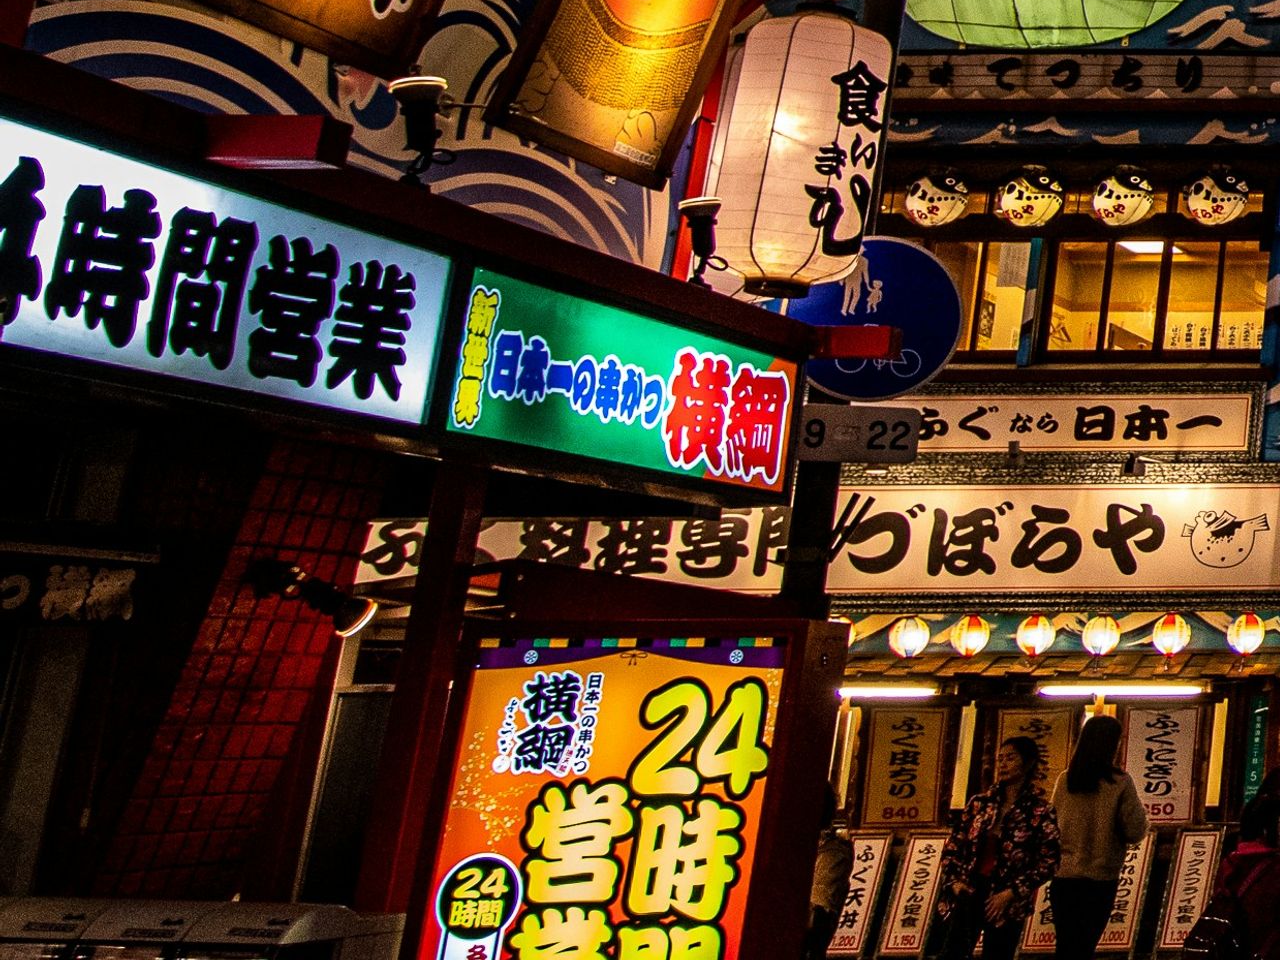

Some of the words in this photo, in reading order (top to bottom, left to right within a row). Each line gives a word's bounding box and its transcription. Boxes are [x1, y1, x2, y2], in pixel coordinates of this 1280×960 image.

[458, 286, 499, 426] 新世界
[488, 334, 665, 430] 日本一の串かつ
[664, 347, 789, 483] 横綱
[362, 508, 791, 577] ふ料理専
[847, 503, 1167, 577] づぼらや
[516, 673, 580, 771] 横綱
[574, 674, 602, 773] 日本一の串かつ
[882, 807, 919, 819] 840
